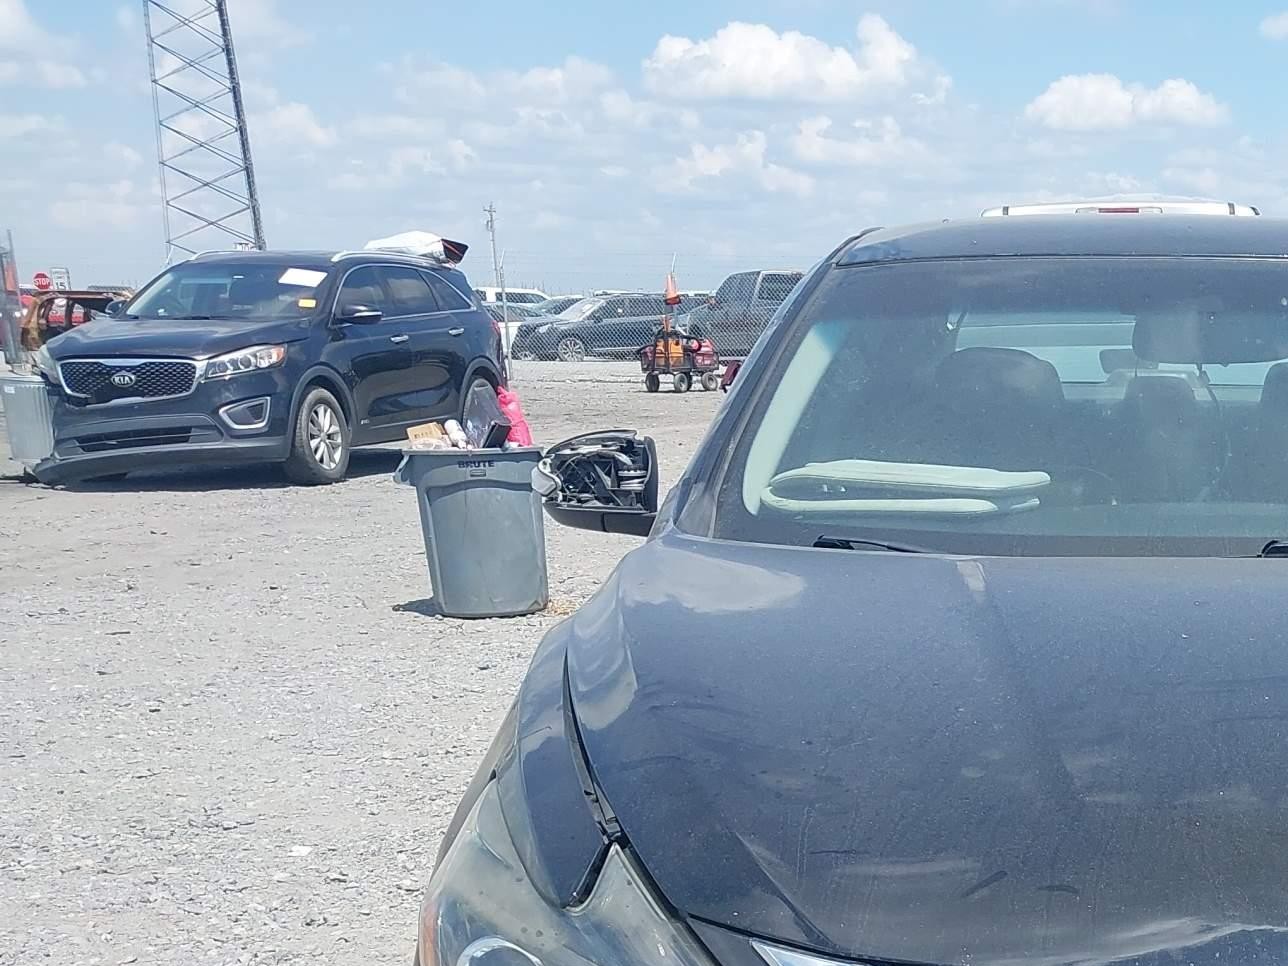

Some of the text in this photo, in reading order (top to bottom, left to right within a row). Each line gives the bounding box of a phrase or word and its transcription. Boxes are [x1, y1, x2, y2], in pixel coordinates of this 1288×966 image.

[34, 277, 50, 285] STOP
[56, 281, 66, 290] 15
[113, 376, 131, 385] KIA
[457, 460, 496, 468] BRUTE
